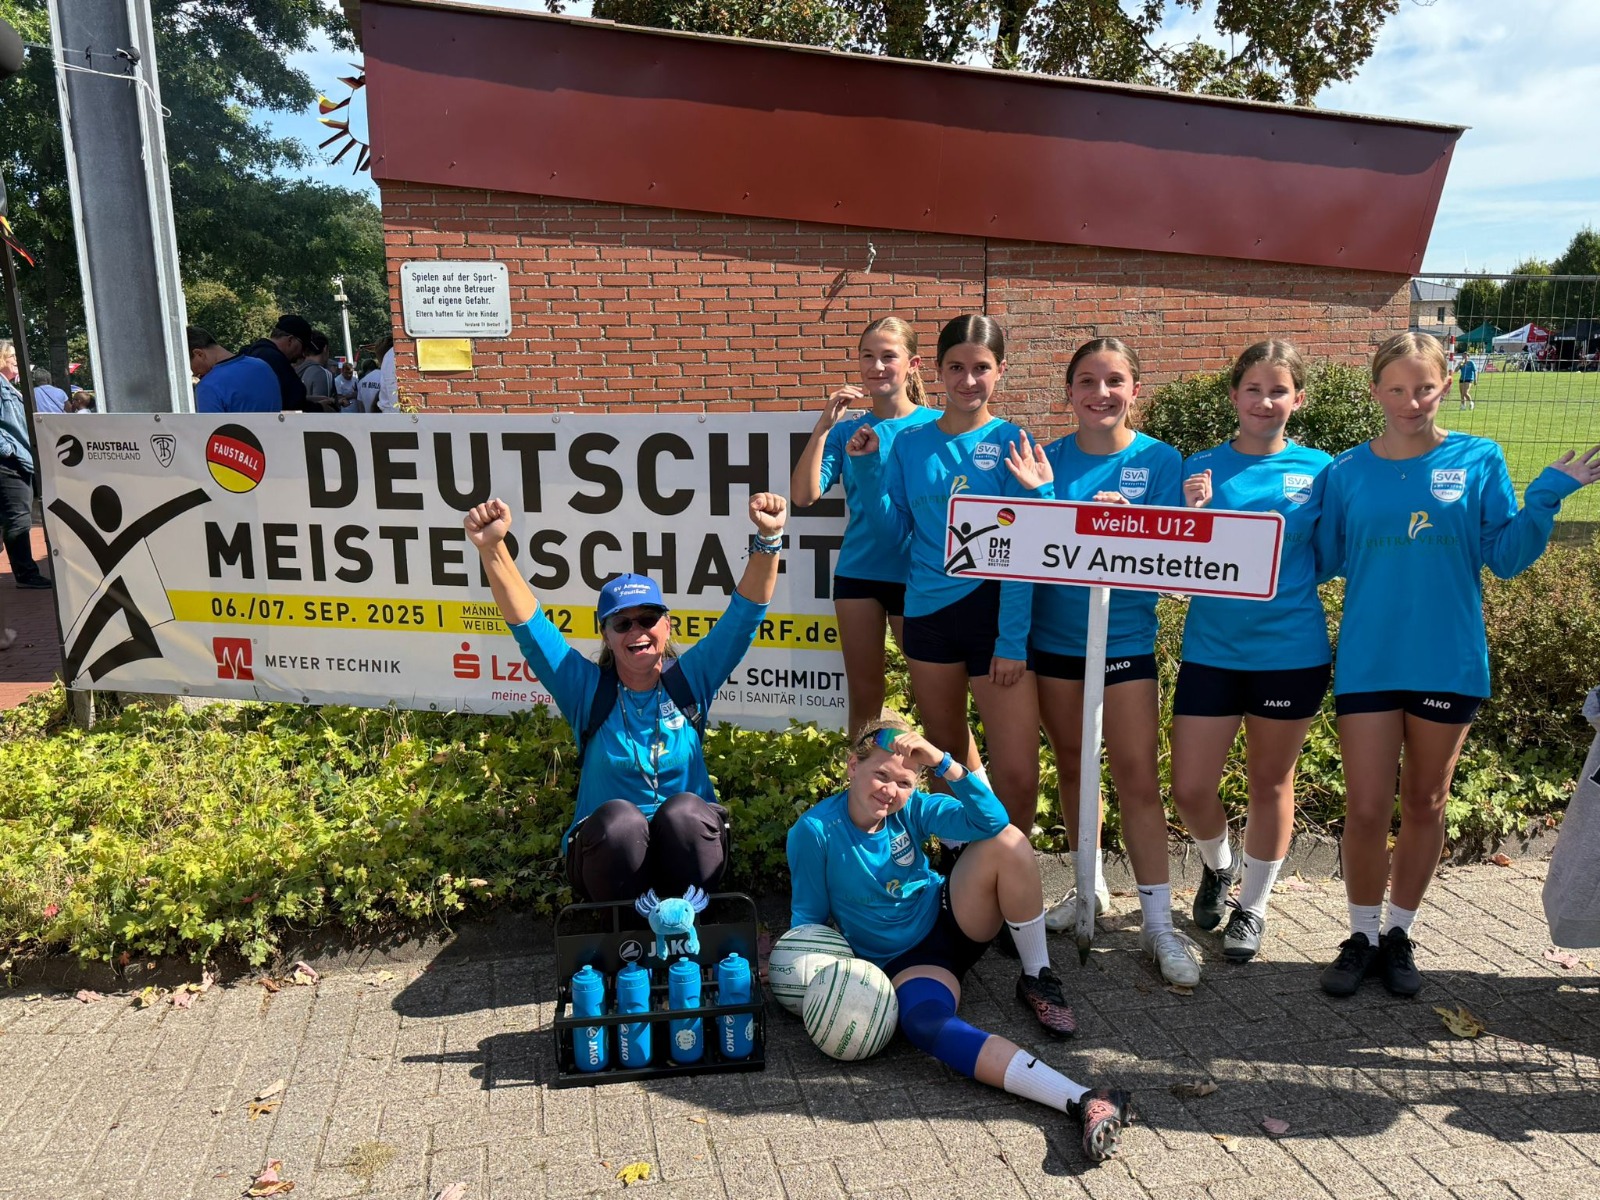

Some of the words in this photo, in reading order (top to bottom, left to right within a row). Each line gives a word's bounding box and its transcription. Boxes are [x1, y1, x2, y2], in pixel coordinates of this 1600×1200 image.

[412, 272, 438, 283] Spielen
[442, 272, 454, 281] auf
[457, 273, 469, 281] der
[473, 272, 497, 283] Sport-
[416, 284, 440, 295] anlage
[443, 284, 461, 293] ohne
[464, 284, 495, 293] Betreuer
[422, 296, 435, 305] auf
[438, 296, 462, 306] eigene
[465, 296, 491, 305] Gefahr.
[480, 310, 499, 318] Kinder
[87, 441, 139, 451] FAUSTBALL
[977, 445, 998, 454] SVA
[87, 451, 141, 461] DEUTSCHLAND
[213, 441, 258, 471] FAUSTBALL
[303, 430, 845, 517] DEUTSCHE
[1124, 471, 1144, 480] SVA
[1436, 473, 1461, 481] SVA
[1092, 514, 1149, 535] weibl.
[1157, 518, 1196, 537] U12
[989, 537, 1011, 549] DM
[989, 549, 1010, 559] U12
[1041, 543, 1082, 569] SV
[1087, 546, 1239, 582] Amstetten
[211, 597, 293, 620] 06./07.
[304, 601, 357, 623] SEP.
[368, 604, 425, 625] 2025
[462, 603, 503, 616] MÄNNL
[463, 620, 506, 632] WEIBL.
[544, 608, 573, 633] 12
[265, 655, 320, 670] MEYER
[326, 657, 401, 674] TECHNIK
[1105, 660, 1131, 673] JAKO
[746, 668, 844, 691] SCHMIDT
[491, 690, 527, 702] meine
[746, 691, 796, 705] SANITÄR
[806, 695, 845, 708] SOLAR
[1263, 699, 1291, 708] JAKO
[1422, 698, 1451, 710] JAKO
[891, 836, 909, 852] SVA
[725, 1027, 735, 1053] JAKO
[588, 1041, 599, 1065] JAKO
[620, 1035, 629, 1061] JAKO
